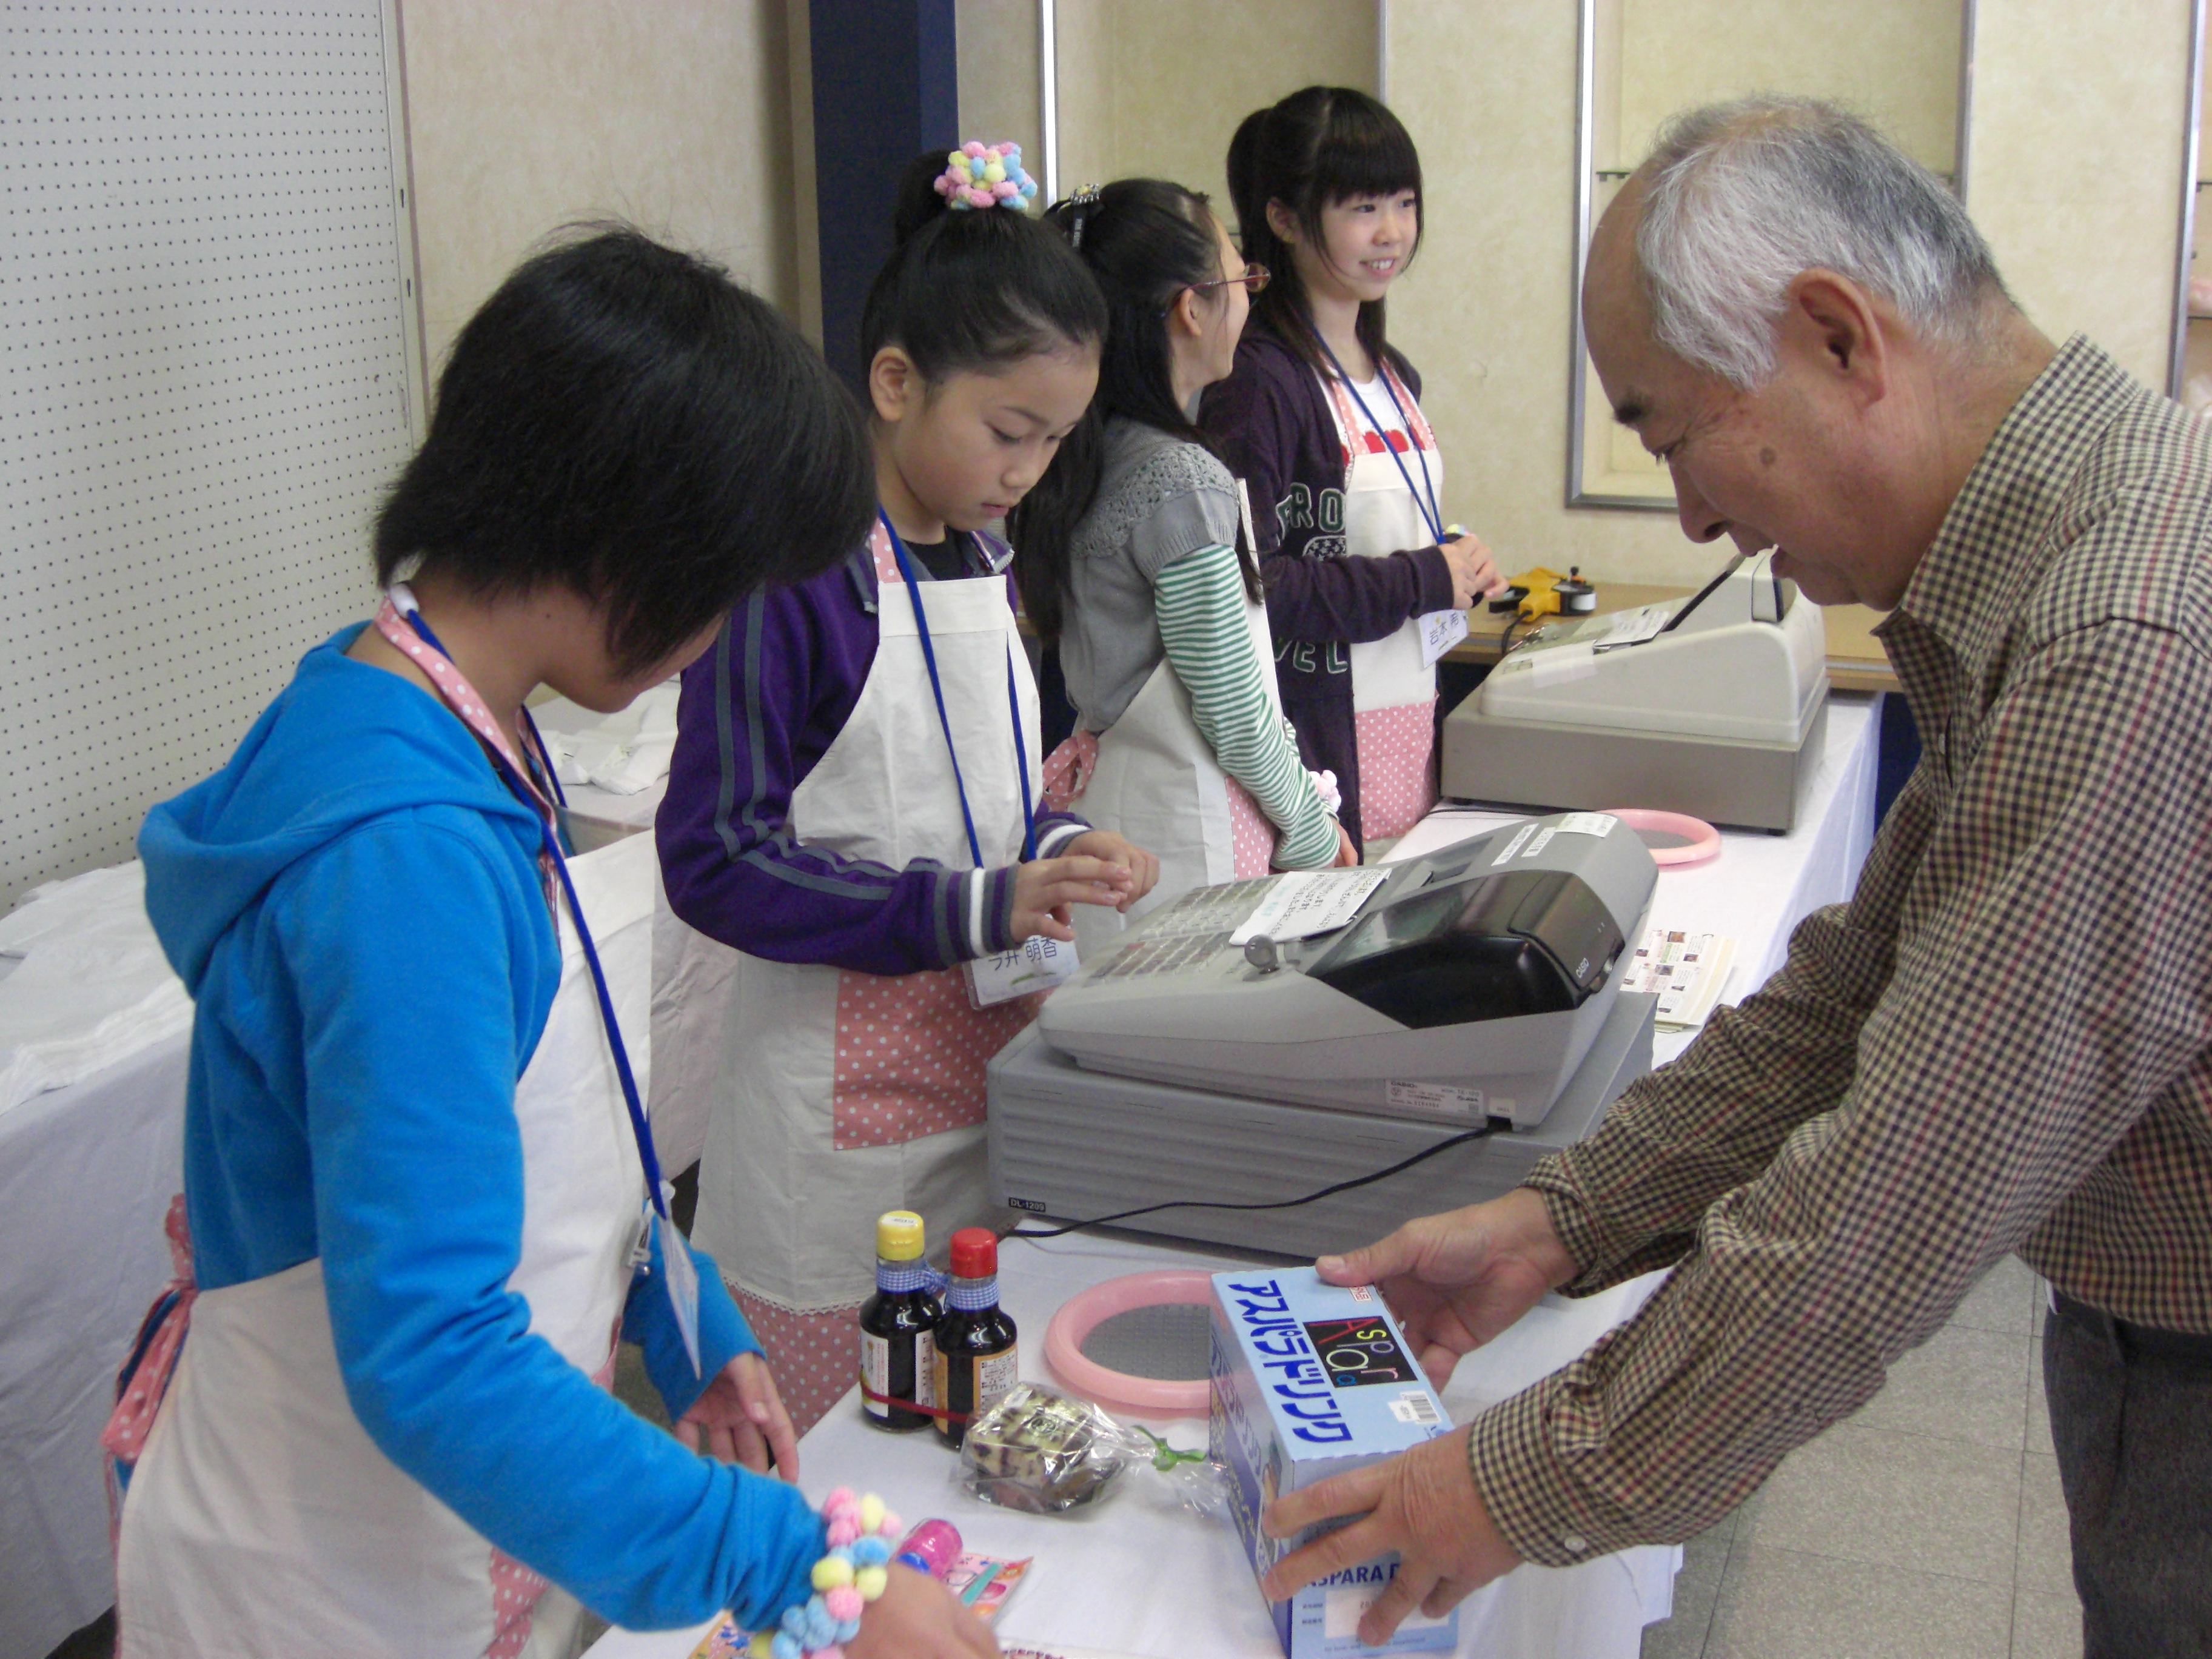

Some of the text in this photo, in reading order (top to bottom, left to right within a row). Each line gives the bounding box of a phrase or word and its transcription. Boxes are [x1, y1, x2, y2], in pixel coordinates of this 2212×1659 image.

[1576, 957, 1589, 979] CASIO
[1227, 1279, 1354, 1443] アスパラドリンク
[1306, 1316, 1399, 1386] Aspara
